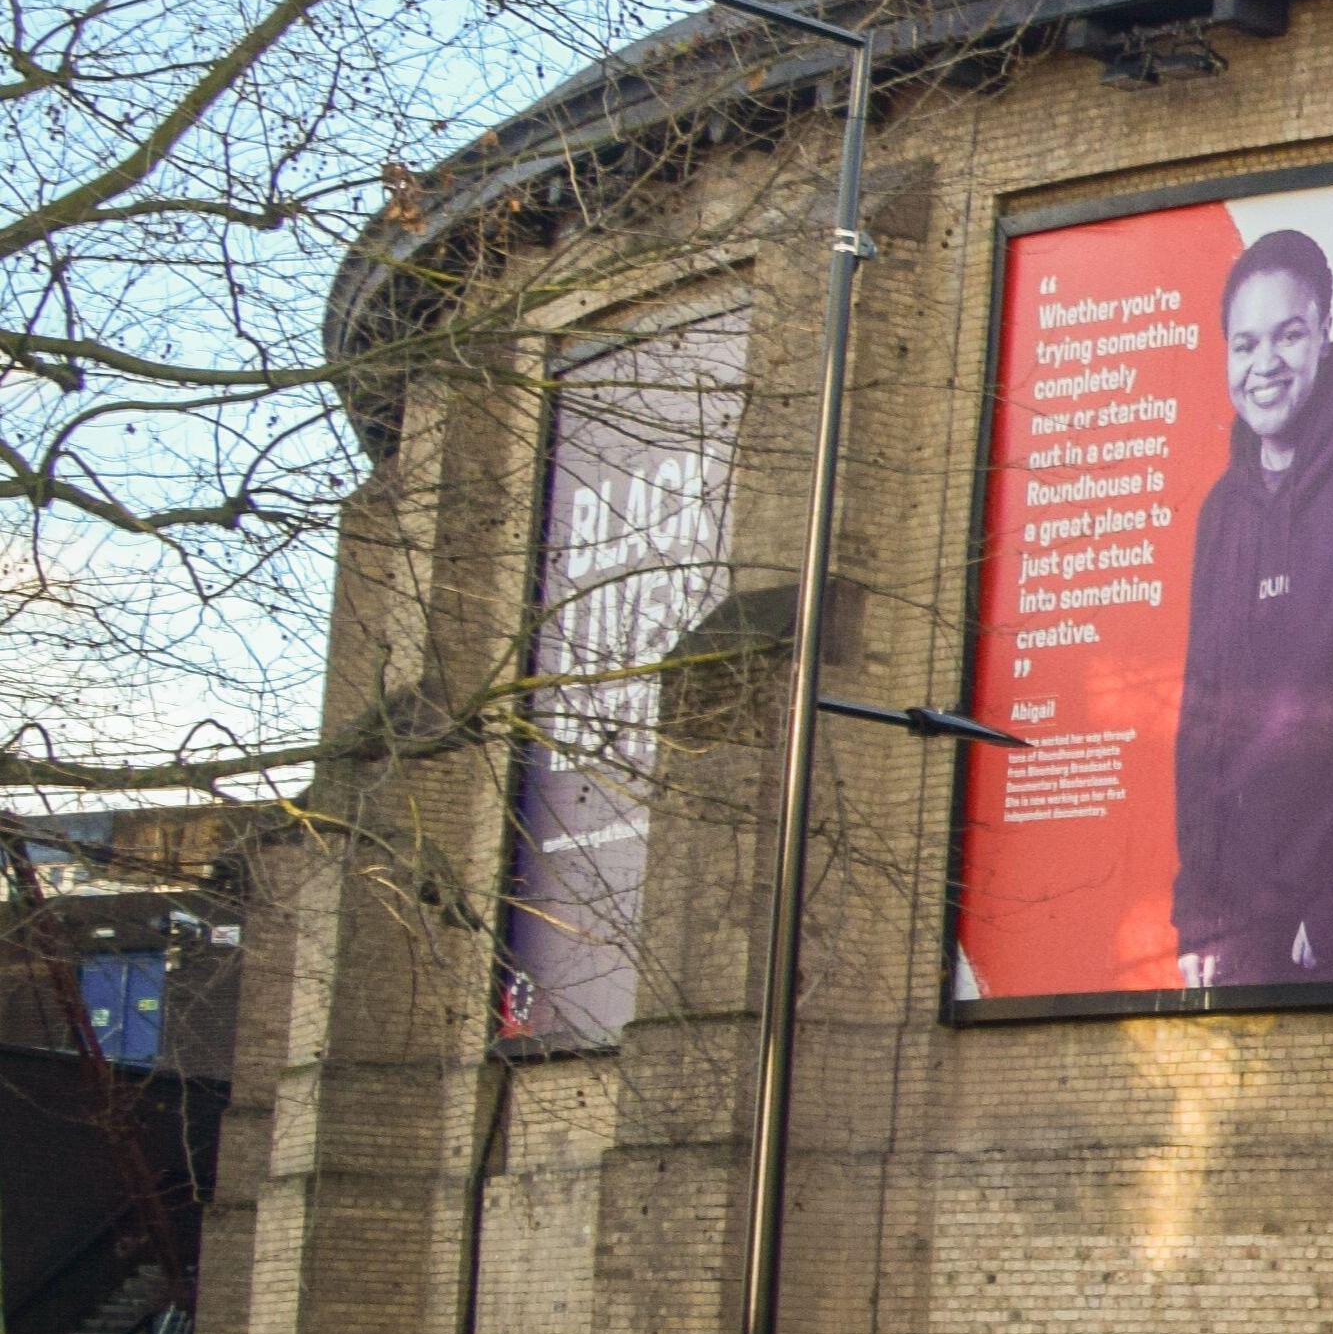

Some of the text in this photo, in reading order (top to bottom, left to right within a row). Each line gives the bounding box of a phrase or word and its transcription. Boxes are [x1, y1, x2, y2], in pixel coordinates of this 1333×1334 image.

[1039, 286, 1181, 329] Whether you're
[1036, 320, 1199, 368] trying something
[1034, 363, 1136, 401] completely
[1031, 395, 1177, 435] new or starting
[1029, 435, 1169, 469] out in a career,
[1027, 467, 1164, 506] Roundhouse is
[566, 446, 715, 578] BLACK
[1024, 503, 1172, 546] a great place to
[1018, 539, 1154, 584] just get stuck
[1019, 577, 1162, 613] into something
[559, 556, 707, 688] LIVES
[1016, 619, 1100, 649] creative.
[1011, 700, 1055, 724] Abigail
